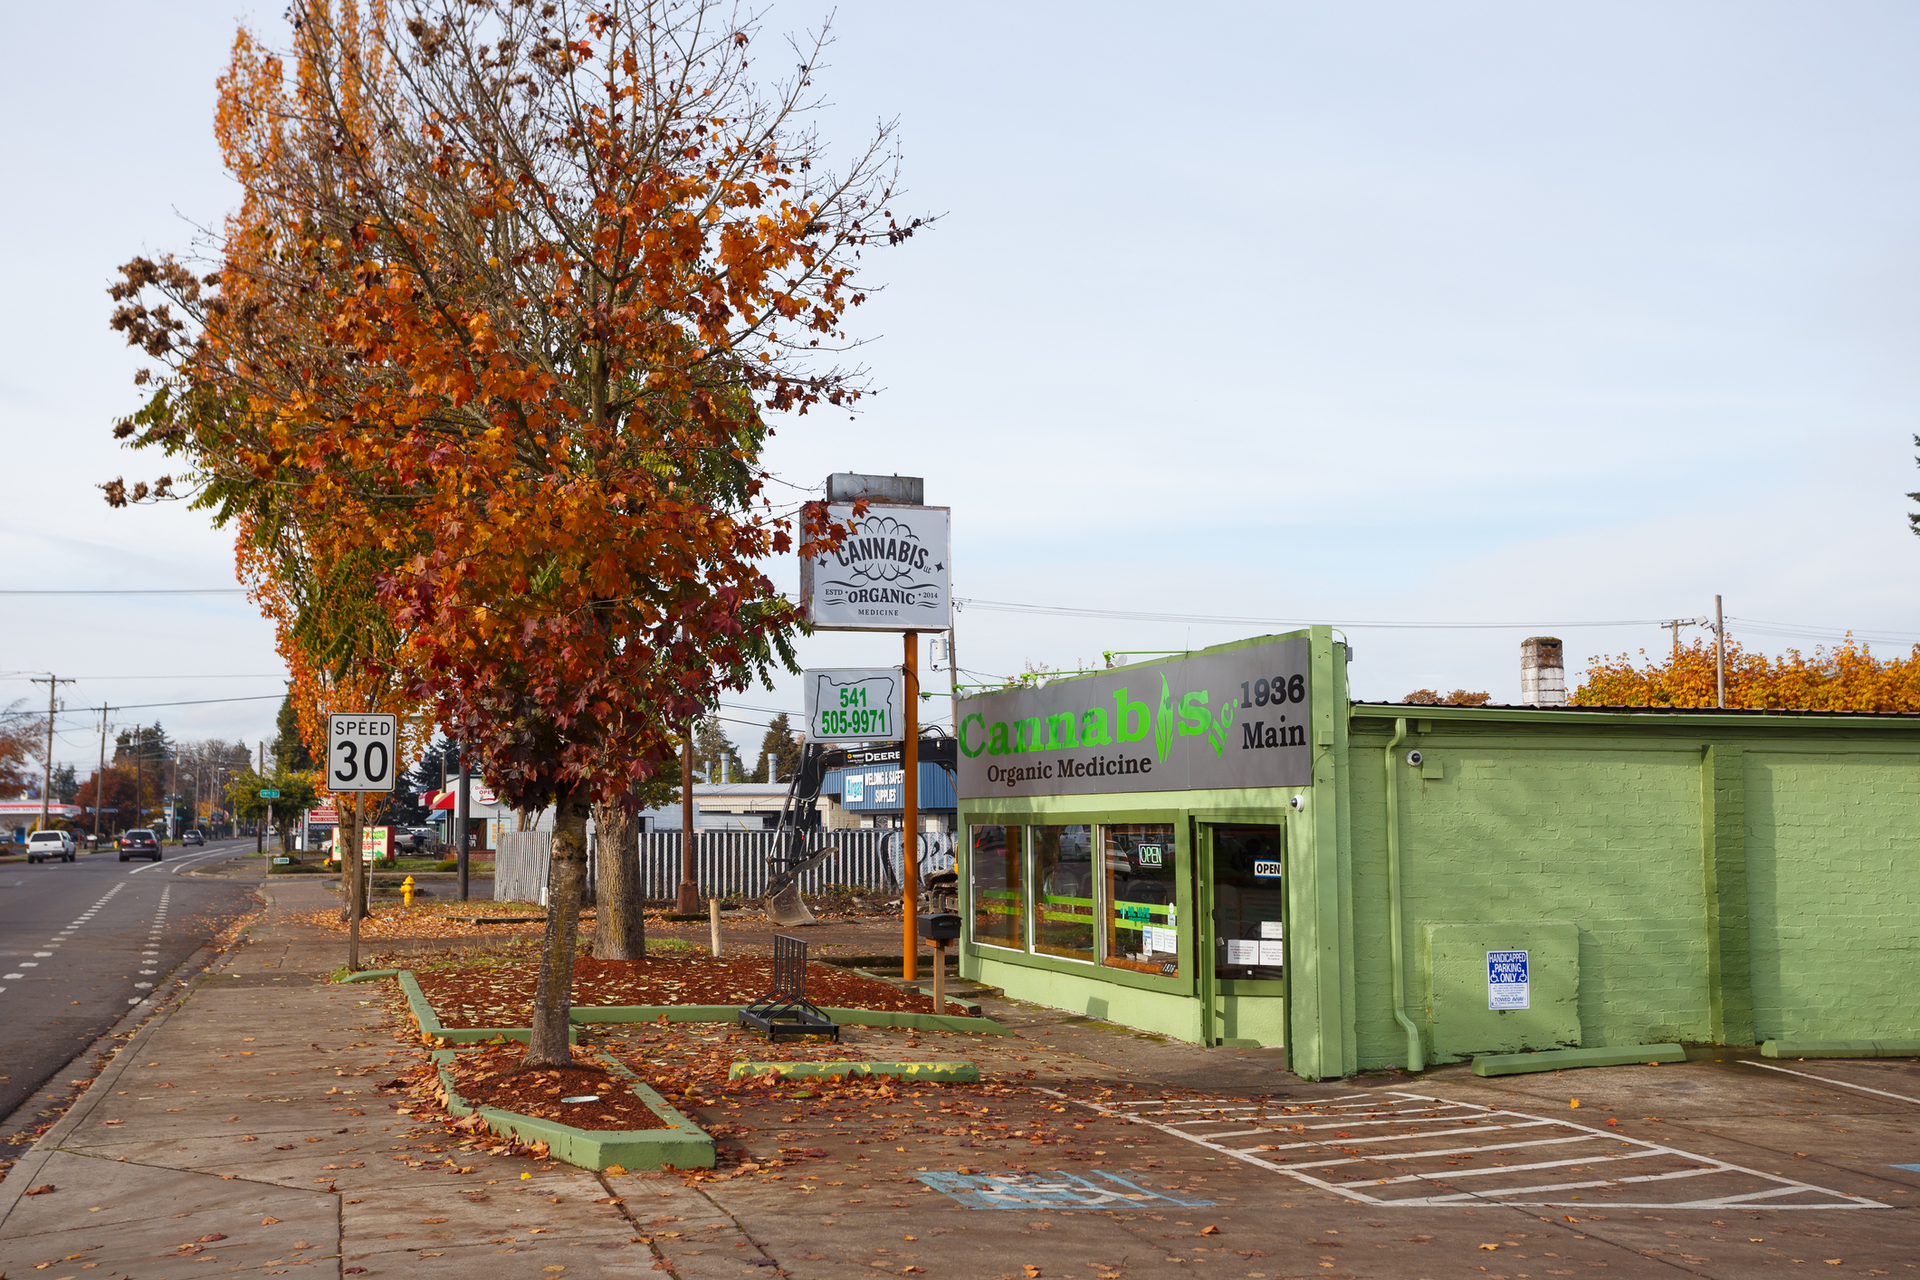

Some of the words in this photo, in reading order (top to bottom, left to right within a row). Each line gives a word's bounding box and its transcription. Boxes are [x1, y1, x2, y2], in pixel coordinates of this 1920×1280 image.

[835, 537, 929, 570] CANNABIS
[825, 588, 843, 596] ESTD
[848, 587, 916, 605] ORGANIC
[858, 608, 899, 617] MEDICINE
[839, 687, 867, 708] 541
[1240, 673, 1306, 709] 1936
[335, 721, 390, 736] SPEED
[821, 709, 885, 734] 505-9971
[1242, 714, 1306, 750] Main
[335, 740, 388, 783] 30
[865, 751, 900, 762] DEERE
[865, 772, 884, 786] WELDING
[889, 770, 905, 785] SAFET
[987, 761, 1053, 787] Organic
[1057, 754, 1152, 779] Medicine
[875, 788, 897, 803] SUPPLIES
[1140, 846, 1162, 863] OPEN
[1256, 863, 1281, 875] OPEN
[1489, 953, 1526, 963] HANDICAPPED
[1162, 963, 1176, 974] 1936
[1494, 963, 1522, 973] PARKING
[1500, 973, 1517, 983] ONLY
